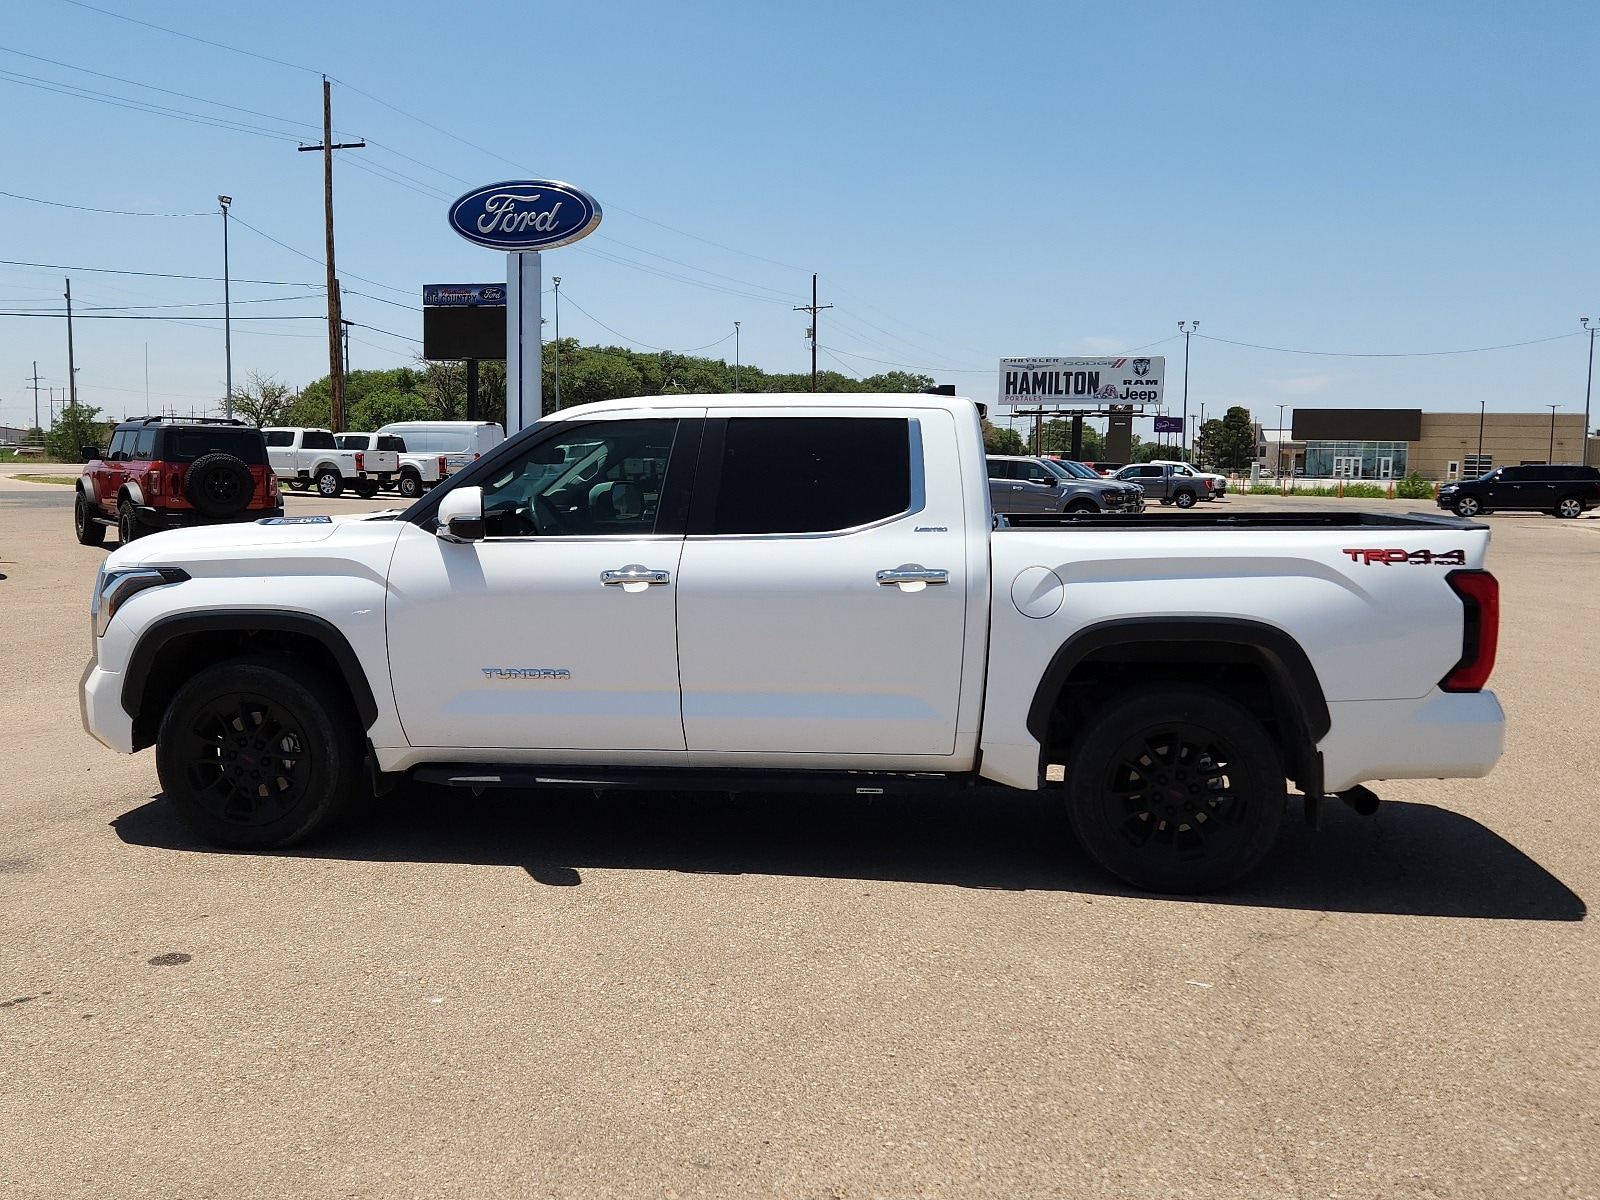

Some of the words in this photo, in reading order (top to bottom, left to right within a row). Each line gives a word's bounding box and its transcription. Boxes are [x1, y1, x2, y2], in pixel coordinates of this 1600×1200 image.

[477, 194, 562, 233] Ford
[441, 294, 477, 303] COUNTRY
[483, 288, 501, 299] Ford
[1005, 371, 1100, 395] HAMILTON
[1119, 387, 1157, 402] Jeep
[1342, 548, 1408, 566] TRD
[482, 667, 571, 680] TUNDRA
